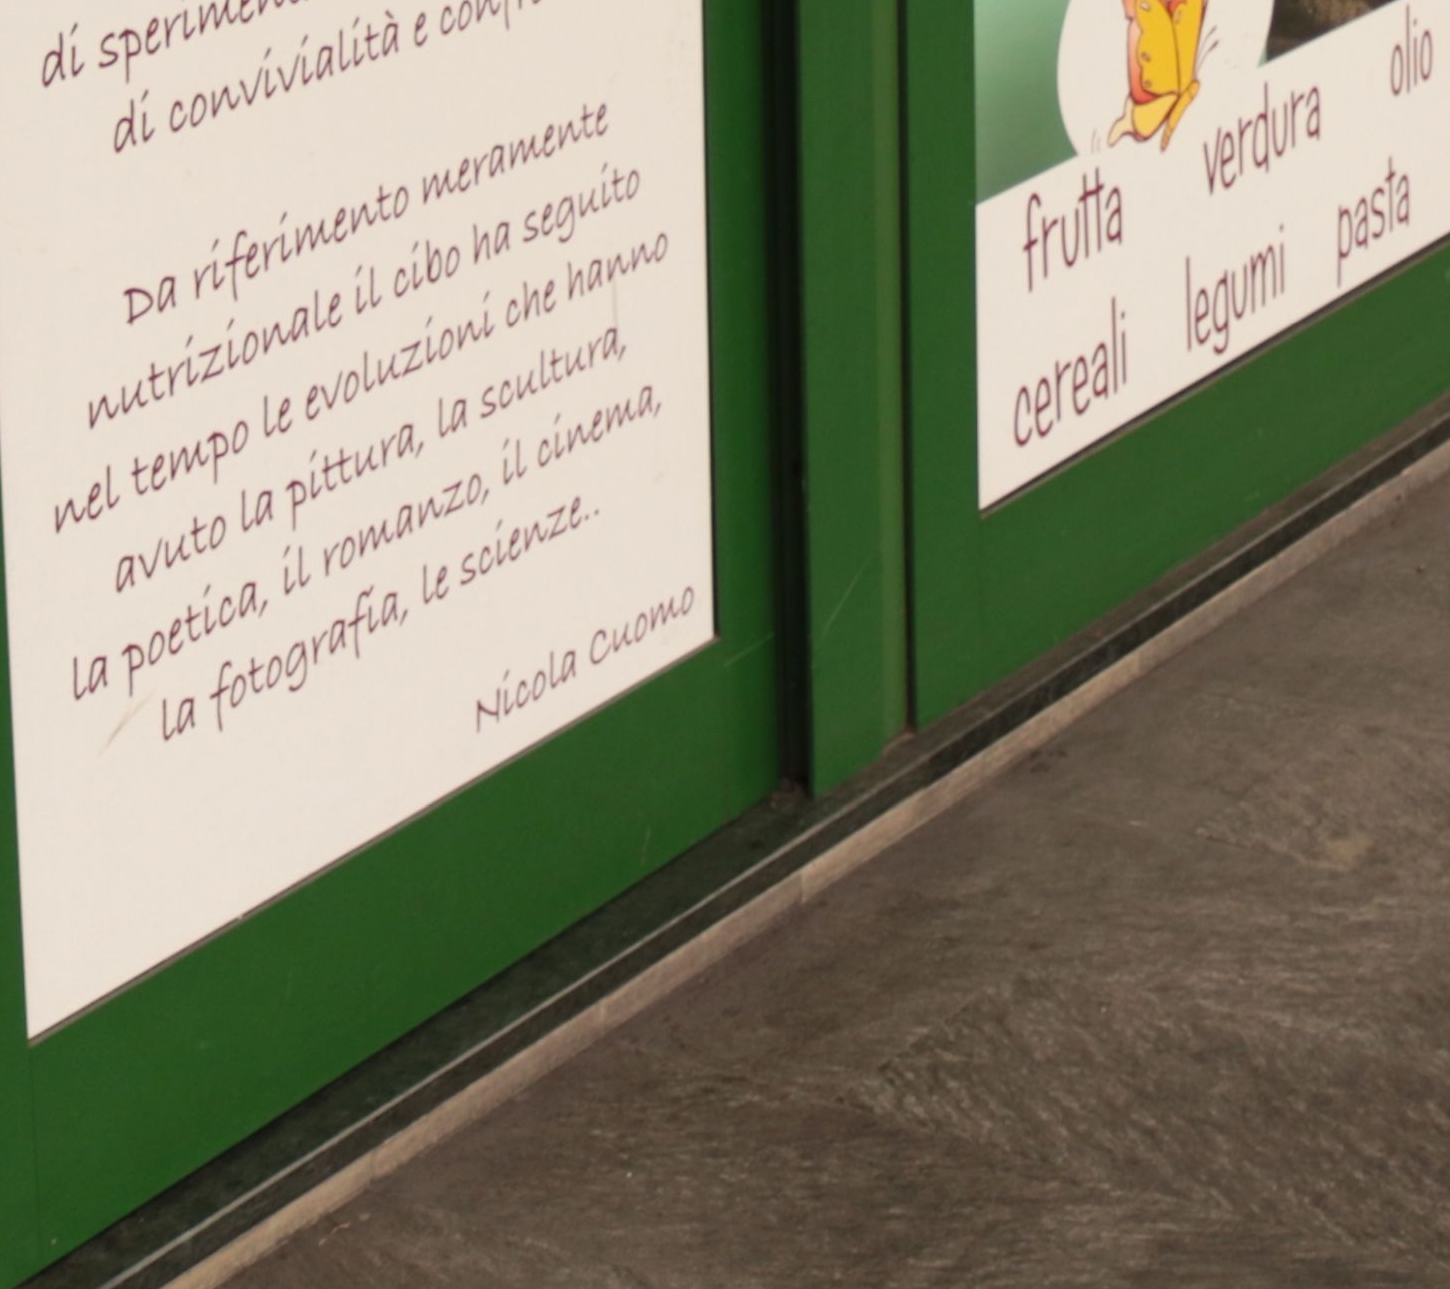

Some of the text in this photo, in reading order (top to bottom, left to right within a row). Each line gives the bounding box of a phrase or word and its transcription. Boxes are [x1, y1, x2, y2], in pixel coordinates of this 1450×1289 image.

[42, 22, 84, 87] di
[112, 91, 154, 153] di
[169, 10, 400, 132] convivialità
[414, 8, 429, 44] e
[1023, 168, 1123, 293] frutta
[1202, 82, 1321, 195] verdura
[1390, 5, 1433, 97] olio
[88, 165, 640, 430] nutrizionale il cibo ha seguito
[125, 101, 609, 323] Da riferimento meramente
[1014, 295, 1127, 447] cereali
[1184, 224, 1285, 356] legumi
[1336, 156, 1411, 288] pasta
[54, 232, 669, 533] nel tempo le evoluzioni che hanno
[116, 324, 628, 594] avuto la pittura, la scultura,
[72, 383, 662, 701] la poetica, il romanzo, il cinema,
[161, 695, 196, 741] la
[210, 587, 409, 731] fotografia,
[421, 564, 449, 605] le
[476, 586, 695, 732] Nicola Cuomo
